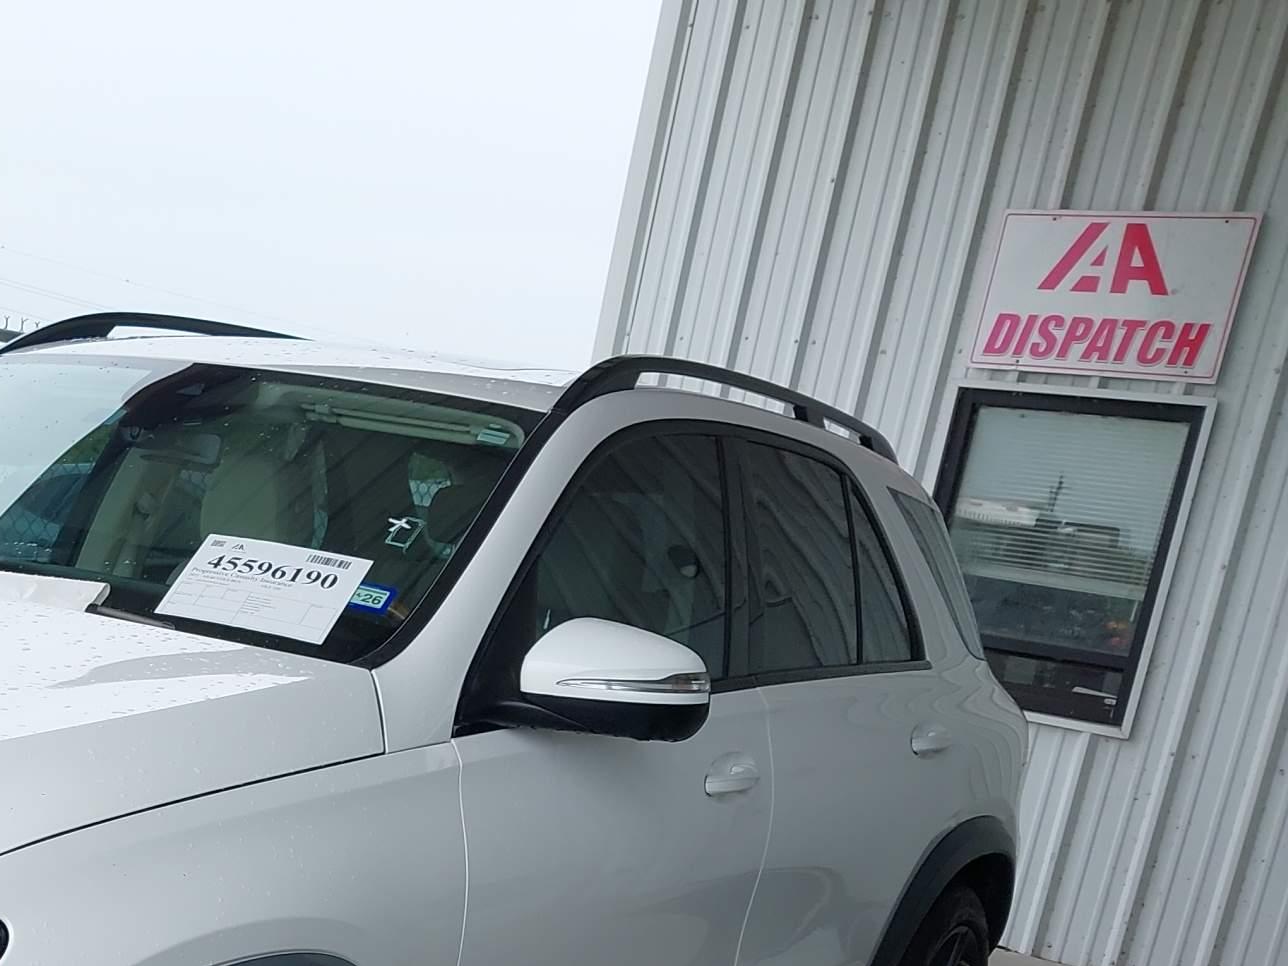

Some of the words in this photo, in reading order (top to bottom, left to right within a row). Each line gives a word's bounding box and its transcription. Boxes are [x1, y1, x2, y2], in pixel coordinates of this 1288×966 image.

[982, 313, 1211, 368] DISPATCH
[207, 554, 339, 590] 45596190
[360, 593, 383, 605] 26
